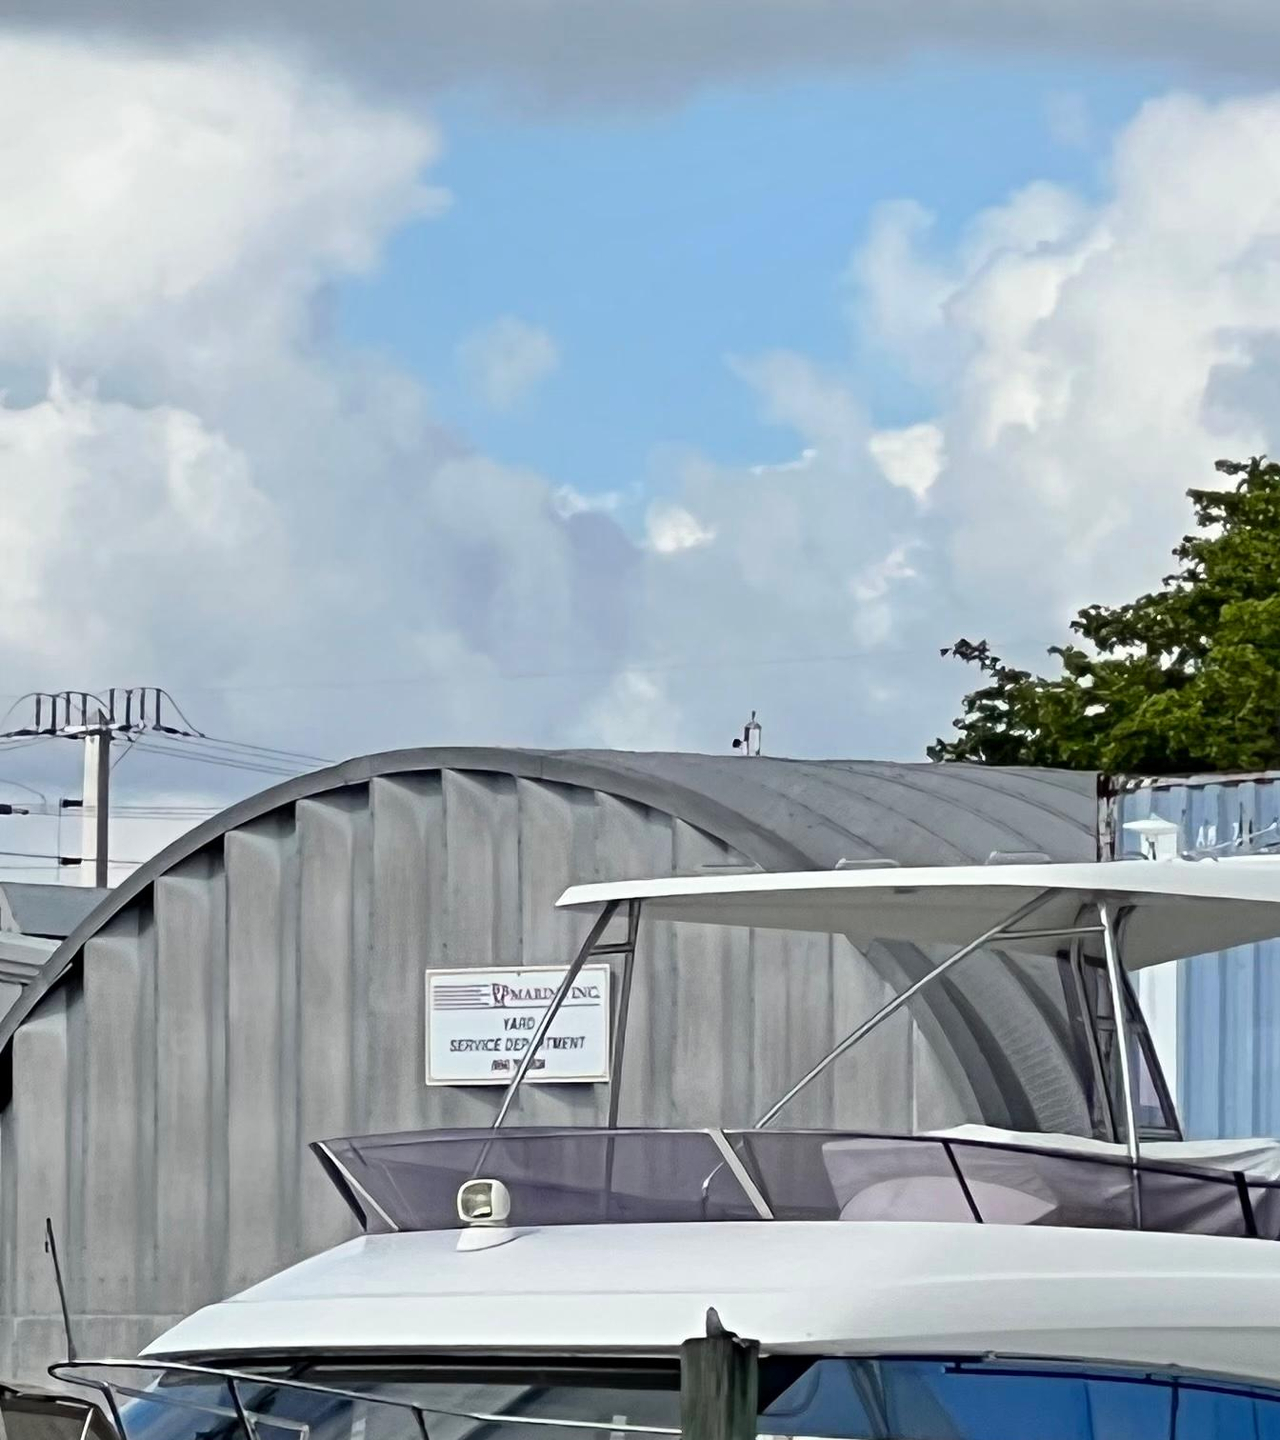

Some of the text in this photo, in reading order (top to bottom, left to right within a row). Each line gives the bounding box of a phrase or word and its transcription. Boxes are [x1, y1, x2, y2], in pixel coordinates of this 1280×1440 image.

[503, 1016, 536, 1031] YARD
[450, 1036, 586, 1052] SERVICE DEPTMENT
